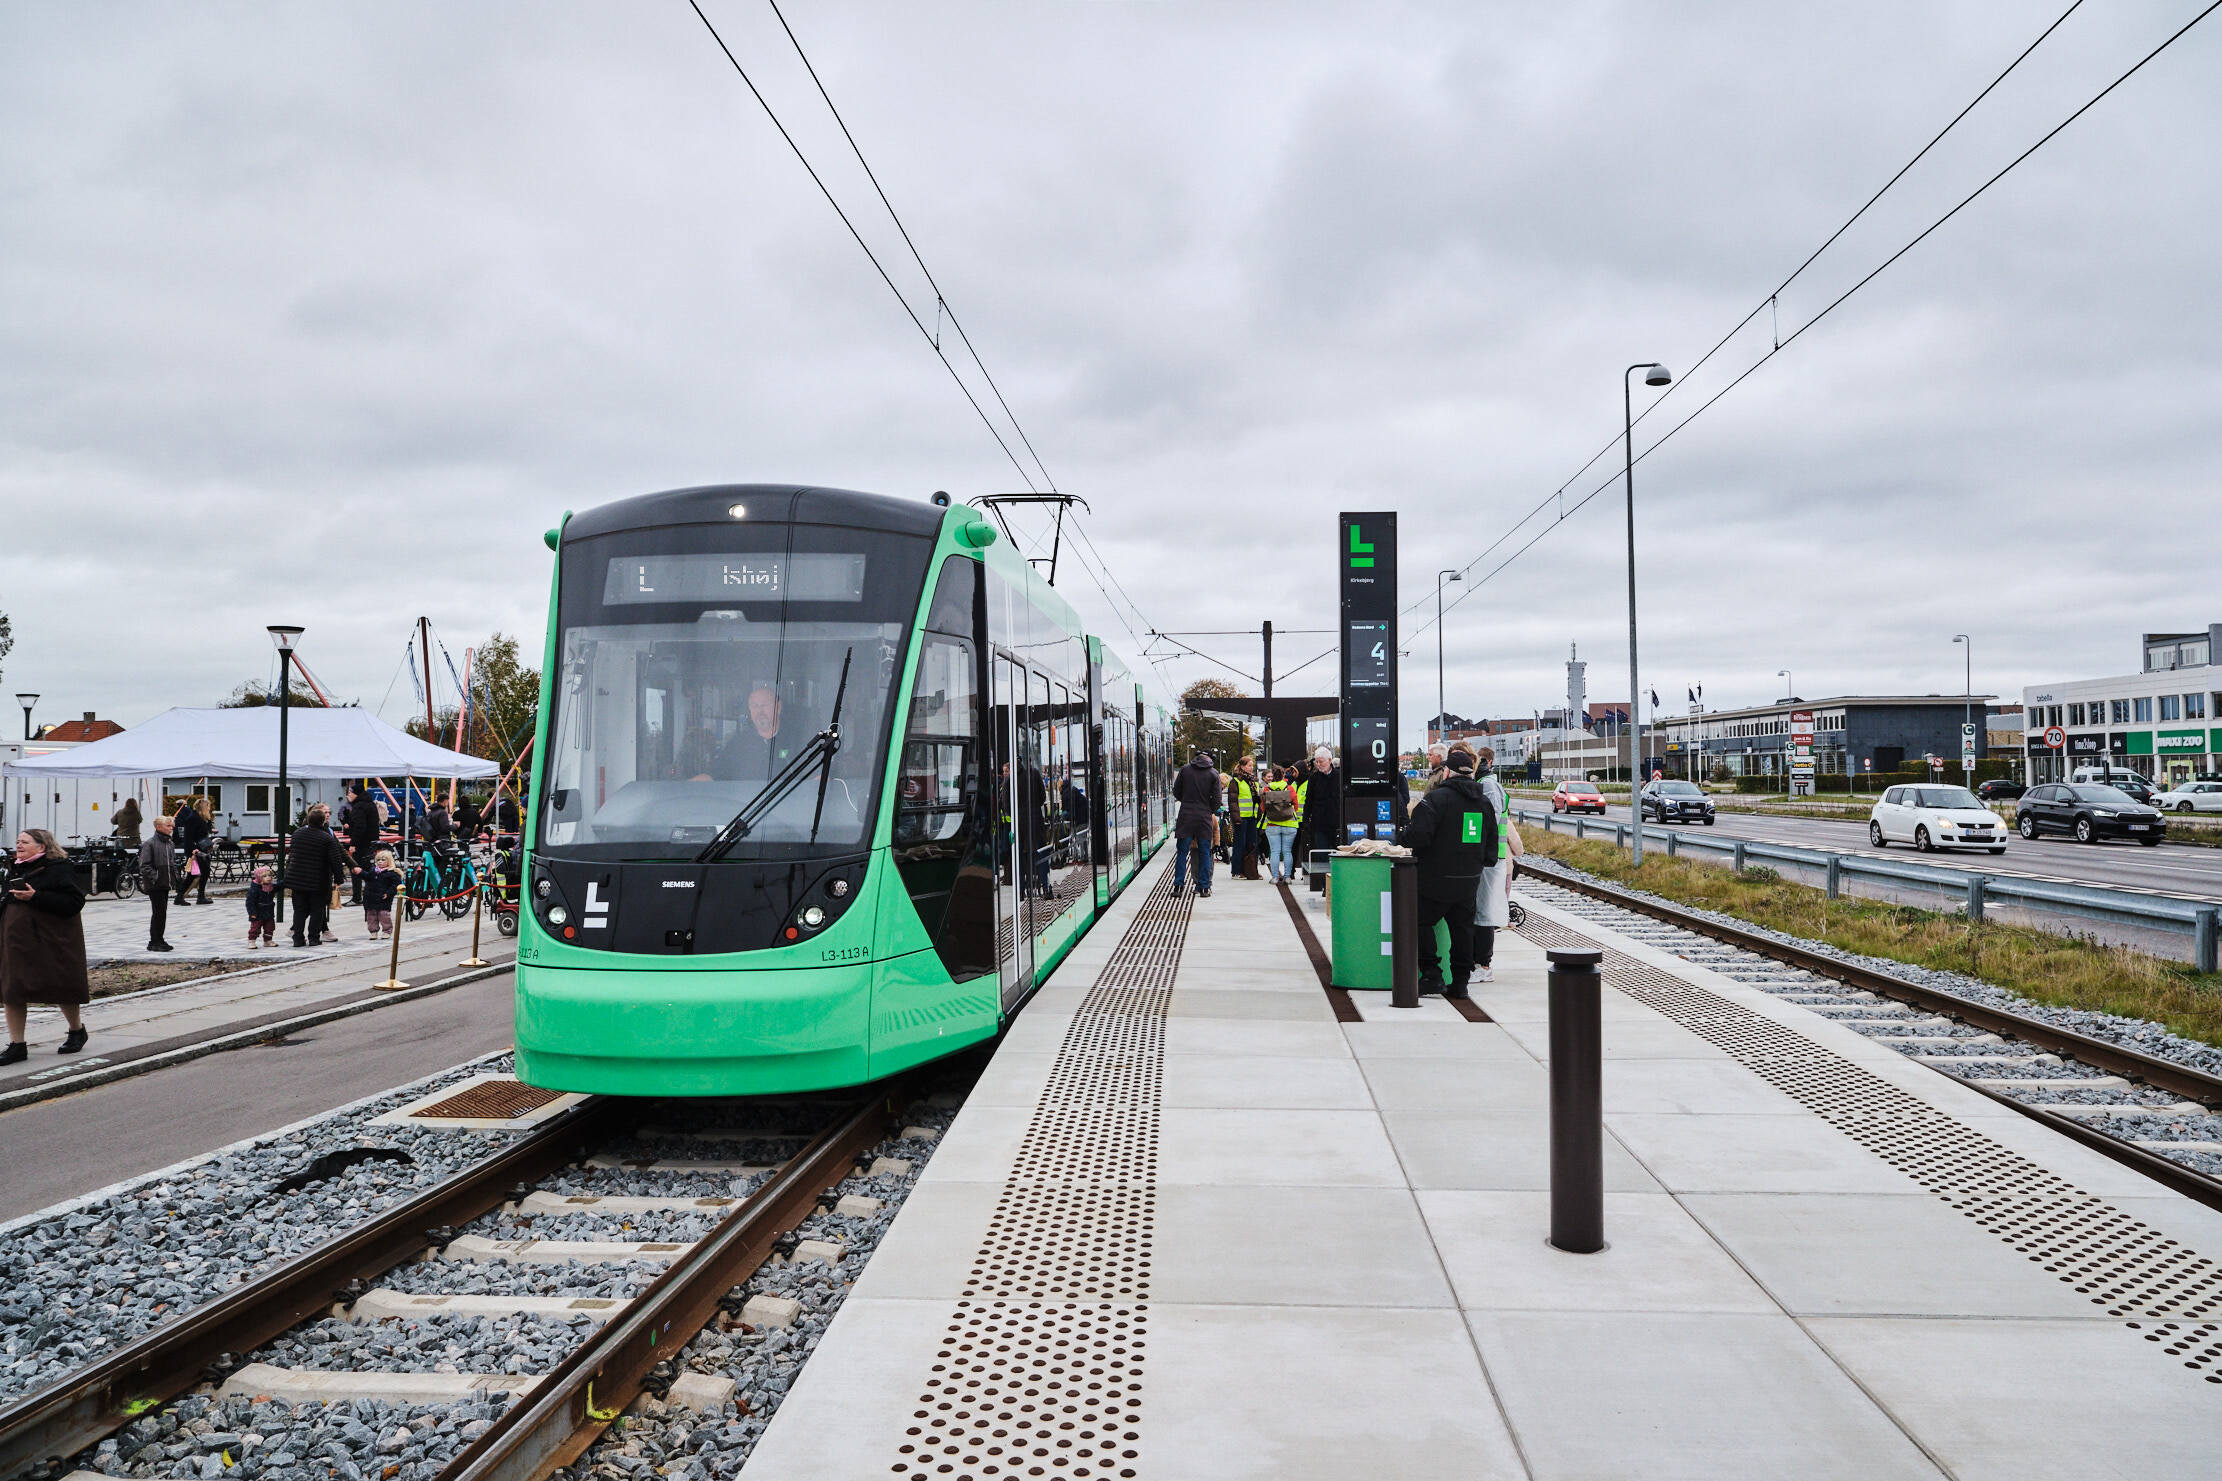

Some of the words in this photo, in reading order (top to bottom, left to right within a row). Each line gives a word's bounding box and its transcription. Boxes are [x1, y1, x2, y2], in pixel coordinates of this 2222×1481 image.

[640, 566, 654, 592] L
[723, 564, 778, 591] Ishøj
[1371, 641, 1385, 660] 4
[2048, 732, 2062, 742] 70
[2157, 736, 2182, 748] MAXI
[2183, 735, 2204, 747] ZOO
[1371, 739, 1386, 759] 0
[661, 880, 696, 888] SIEMENS
